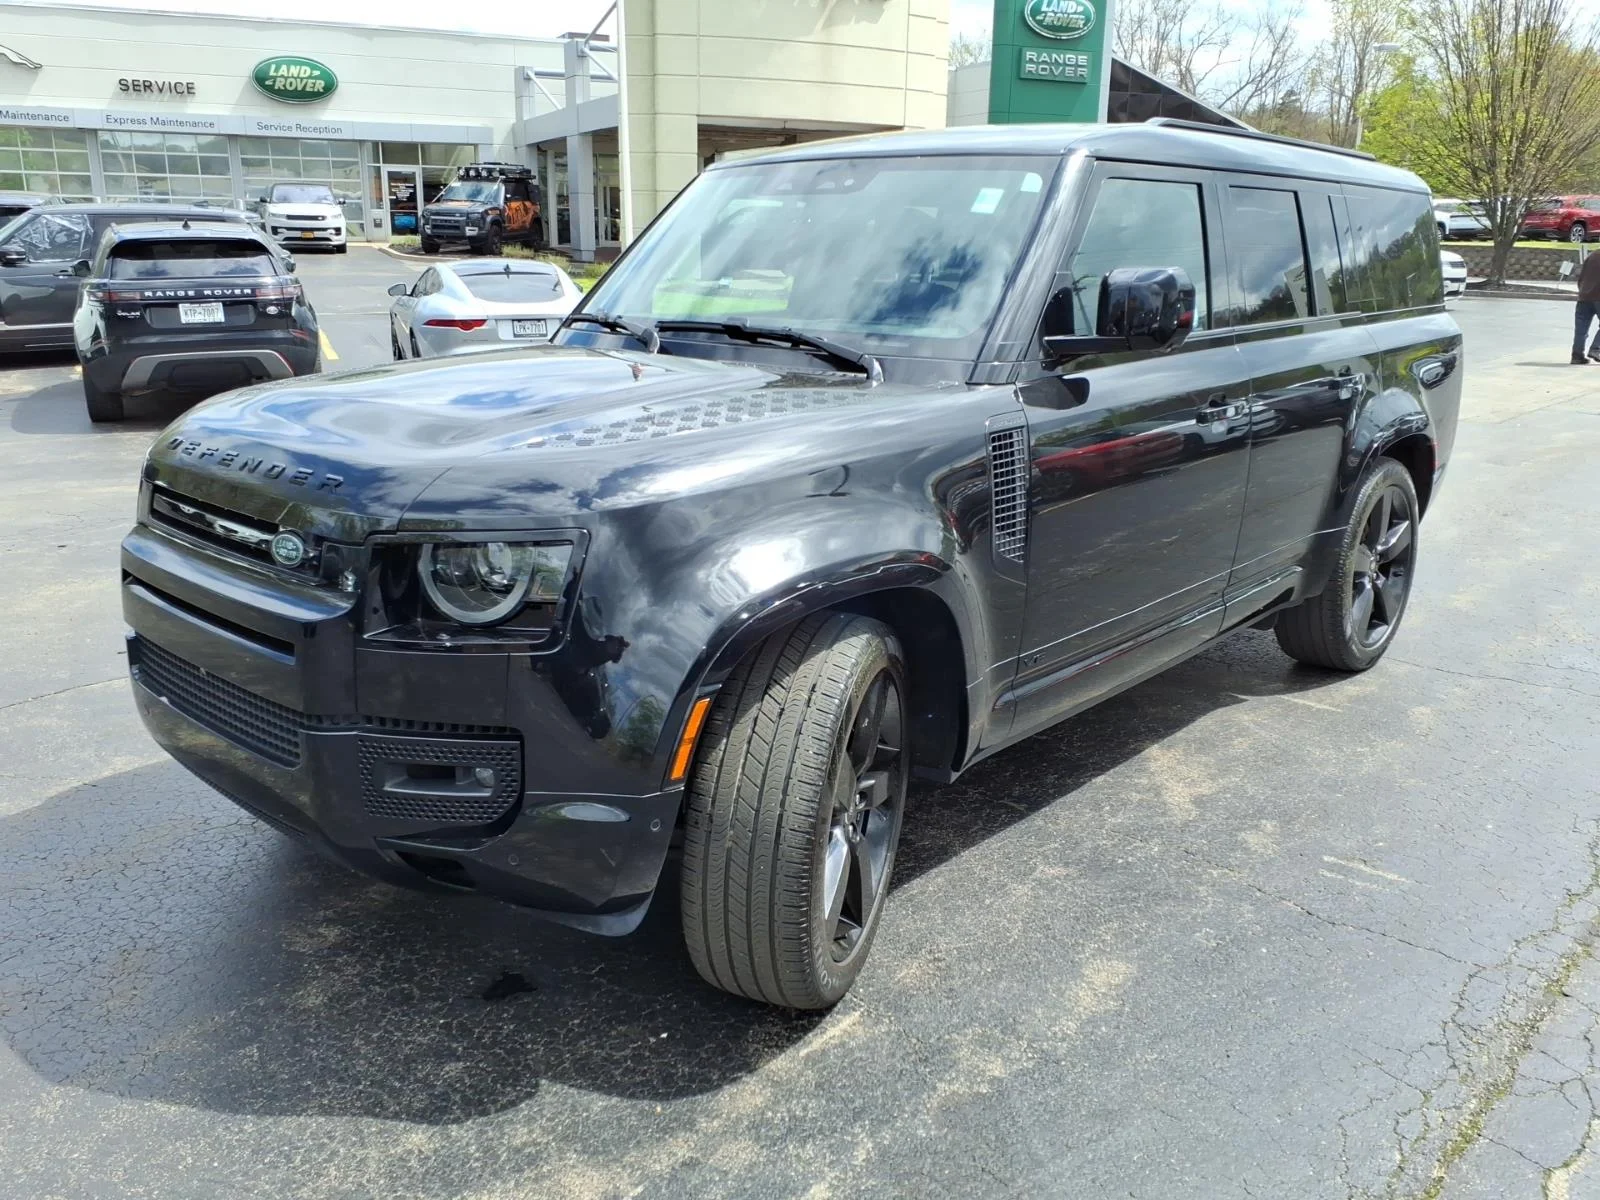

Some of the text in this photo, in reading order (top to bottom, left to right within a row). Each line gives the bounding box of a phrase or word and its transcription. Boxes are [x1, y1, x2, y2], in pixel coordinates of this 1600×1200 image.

[1041, 0, 1077, 14] LAND
[1042, 12, 1086, 28] ROVER
[1025, 51, 1088, 66] RANGE
[269, 63, 311, 78] LAND
[1025, 63, 1088, 78] ROVER
[118, 78, 196, 95] SERVICE
[274, 77, 326, 92] ROVER
[0, 110, 69, 122] Maintenance
[105, 114, 215, 128] Express Maintenance
[256, 121, 343, 135] Service Reception
[144, 288, 252, 298] RANGE ROVER
[167, 436, 345, 496] DEFENDER
